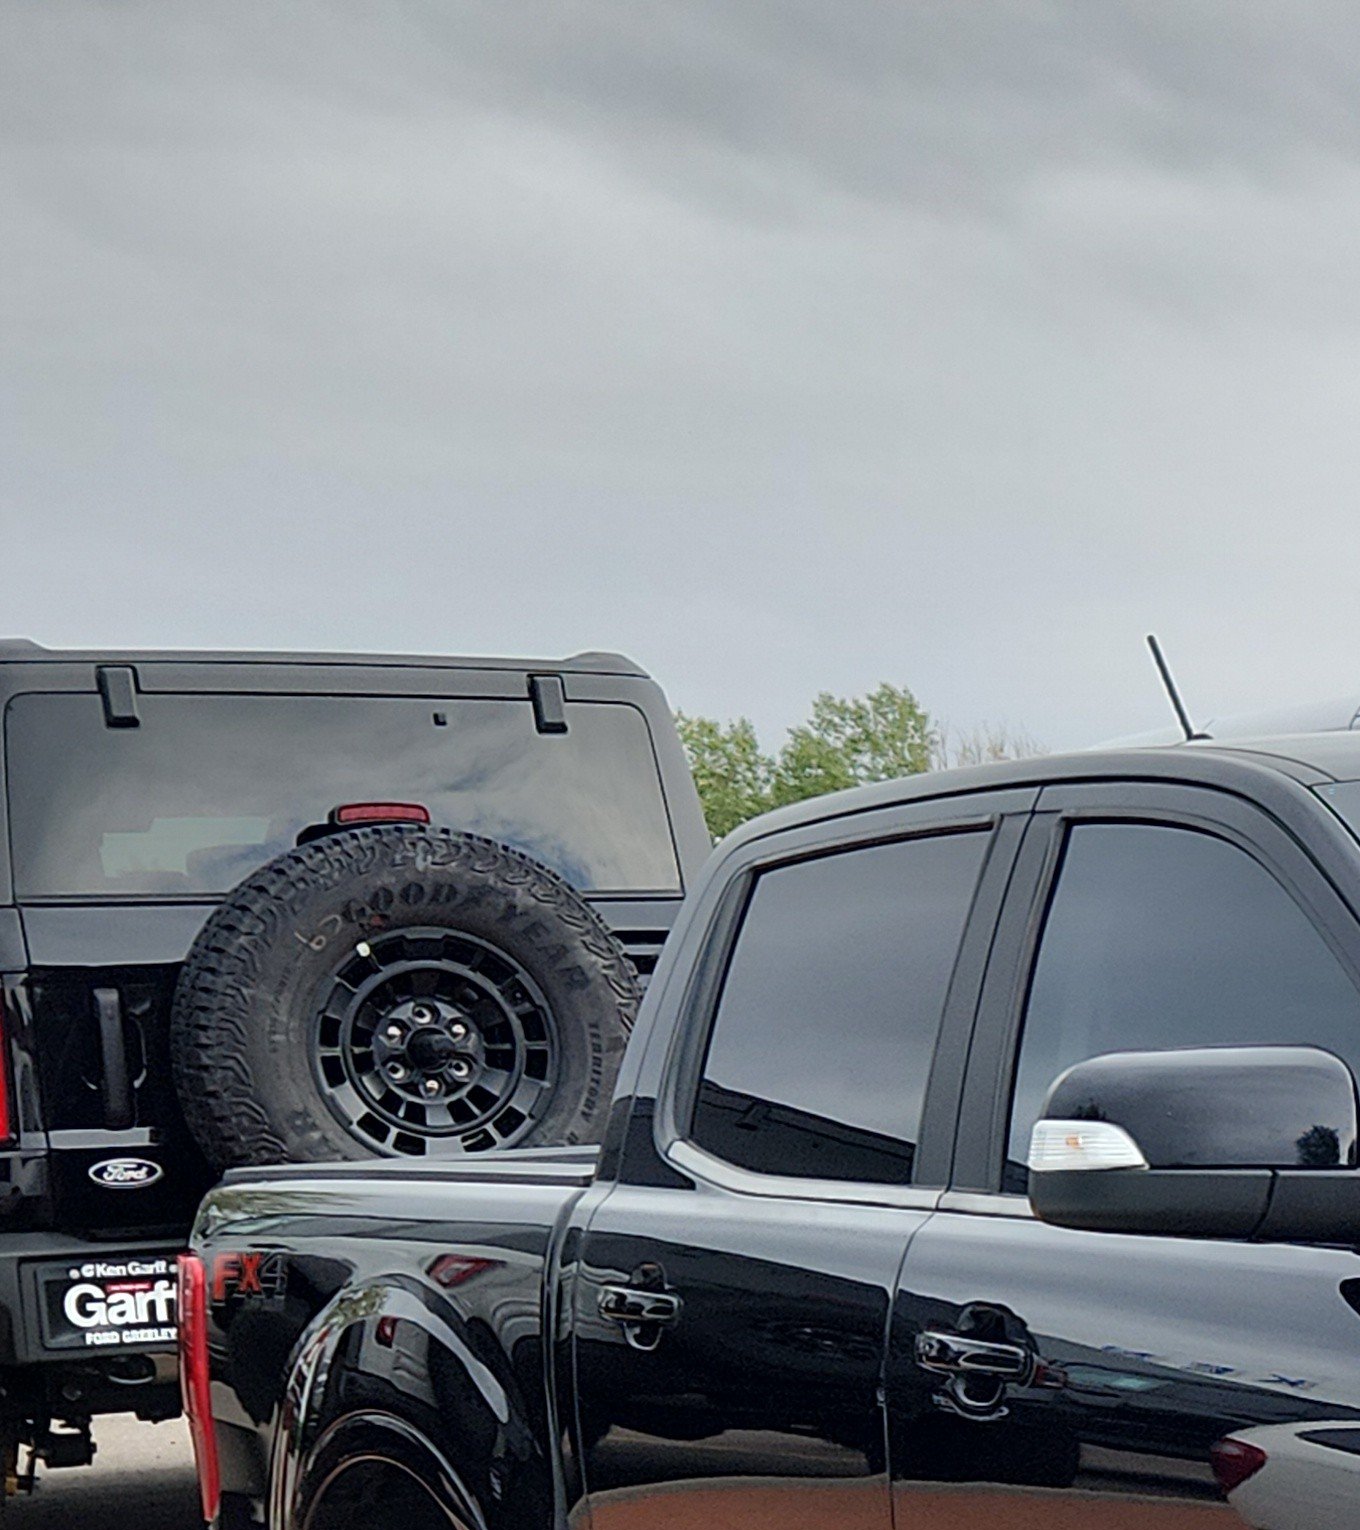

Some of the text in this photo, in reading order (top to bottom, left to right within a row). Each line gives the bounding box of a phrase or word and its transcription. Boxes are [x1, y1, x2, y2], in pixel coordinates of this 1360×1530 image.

[102, 1163, 150, 1181] Ford
[95, 1263, 126, 1277] Ken
[211, 1251, 288, 1303] FX4
[64, 1280, 178, 1328] Garf
[85, 1331, 120, 1345] FORD
